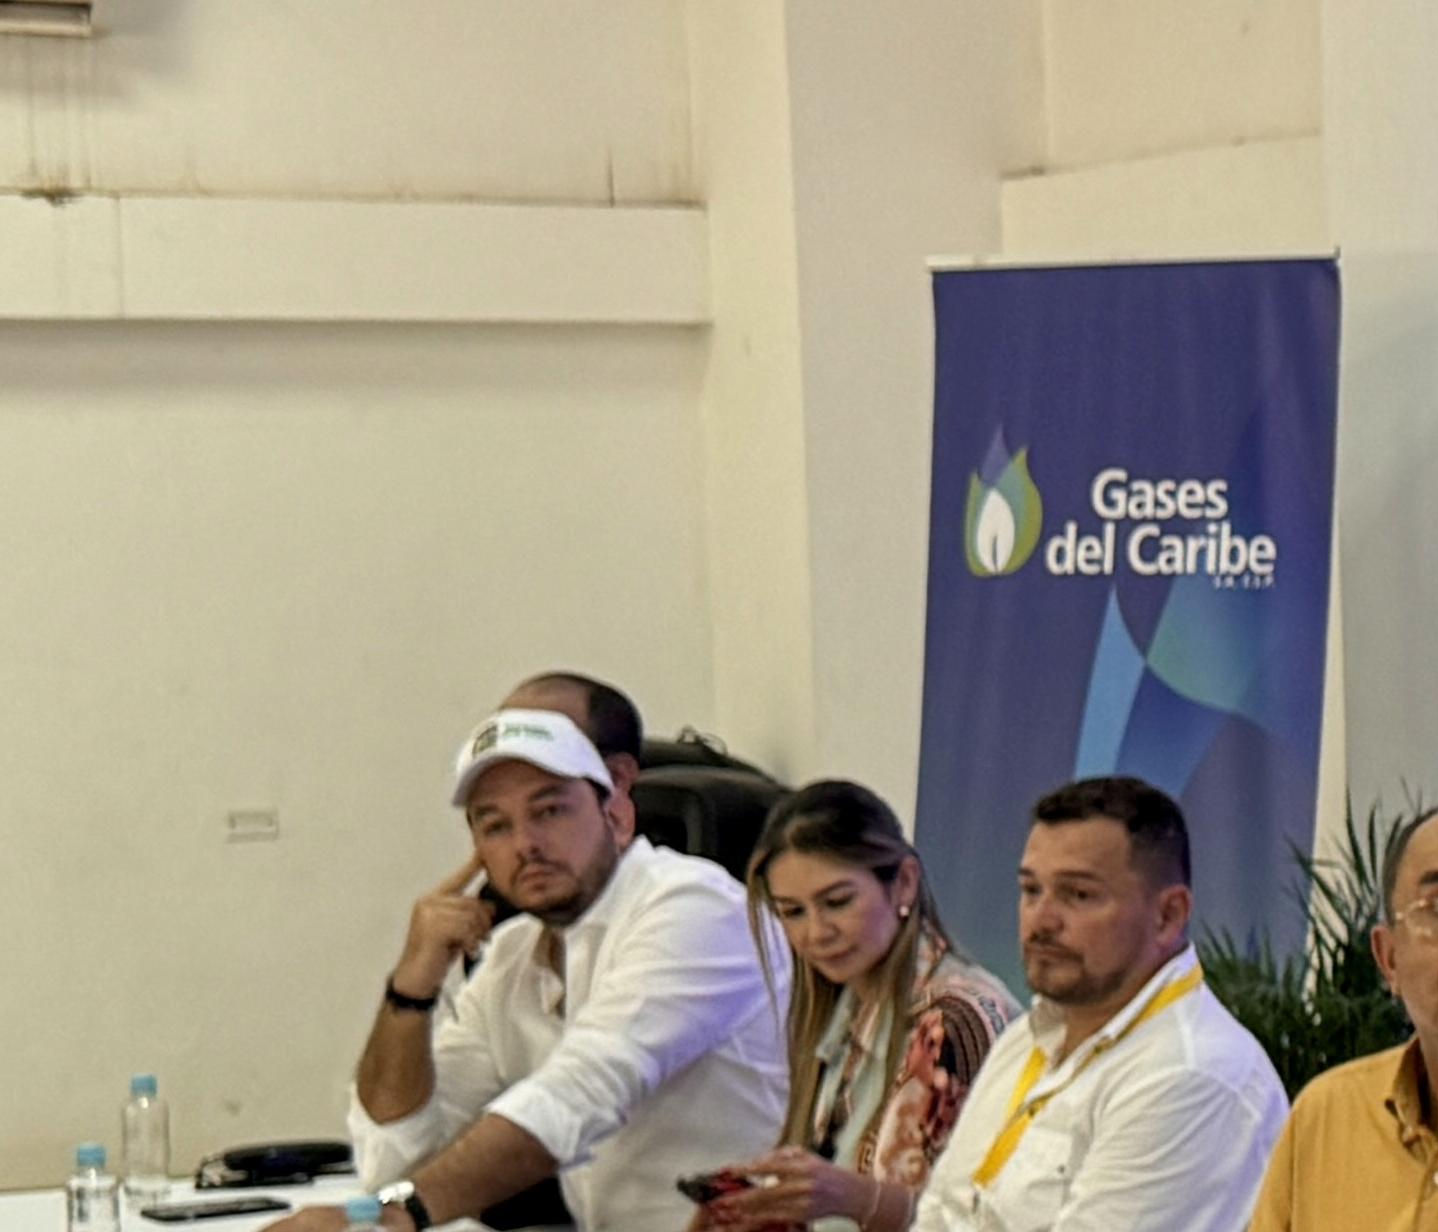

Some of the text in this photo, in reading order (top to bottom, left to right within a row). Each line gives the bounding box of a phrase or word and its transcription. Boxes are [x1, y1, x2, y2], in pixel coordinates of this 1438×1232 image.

[1092, 468, 1228, 520] Gases
[1046, 522, 1276, 575] del Caribe
